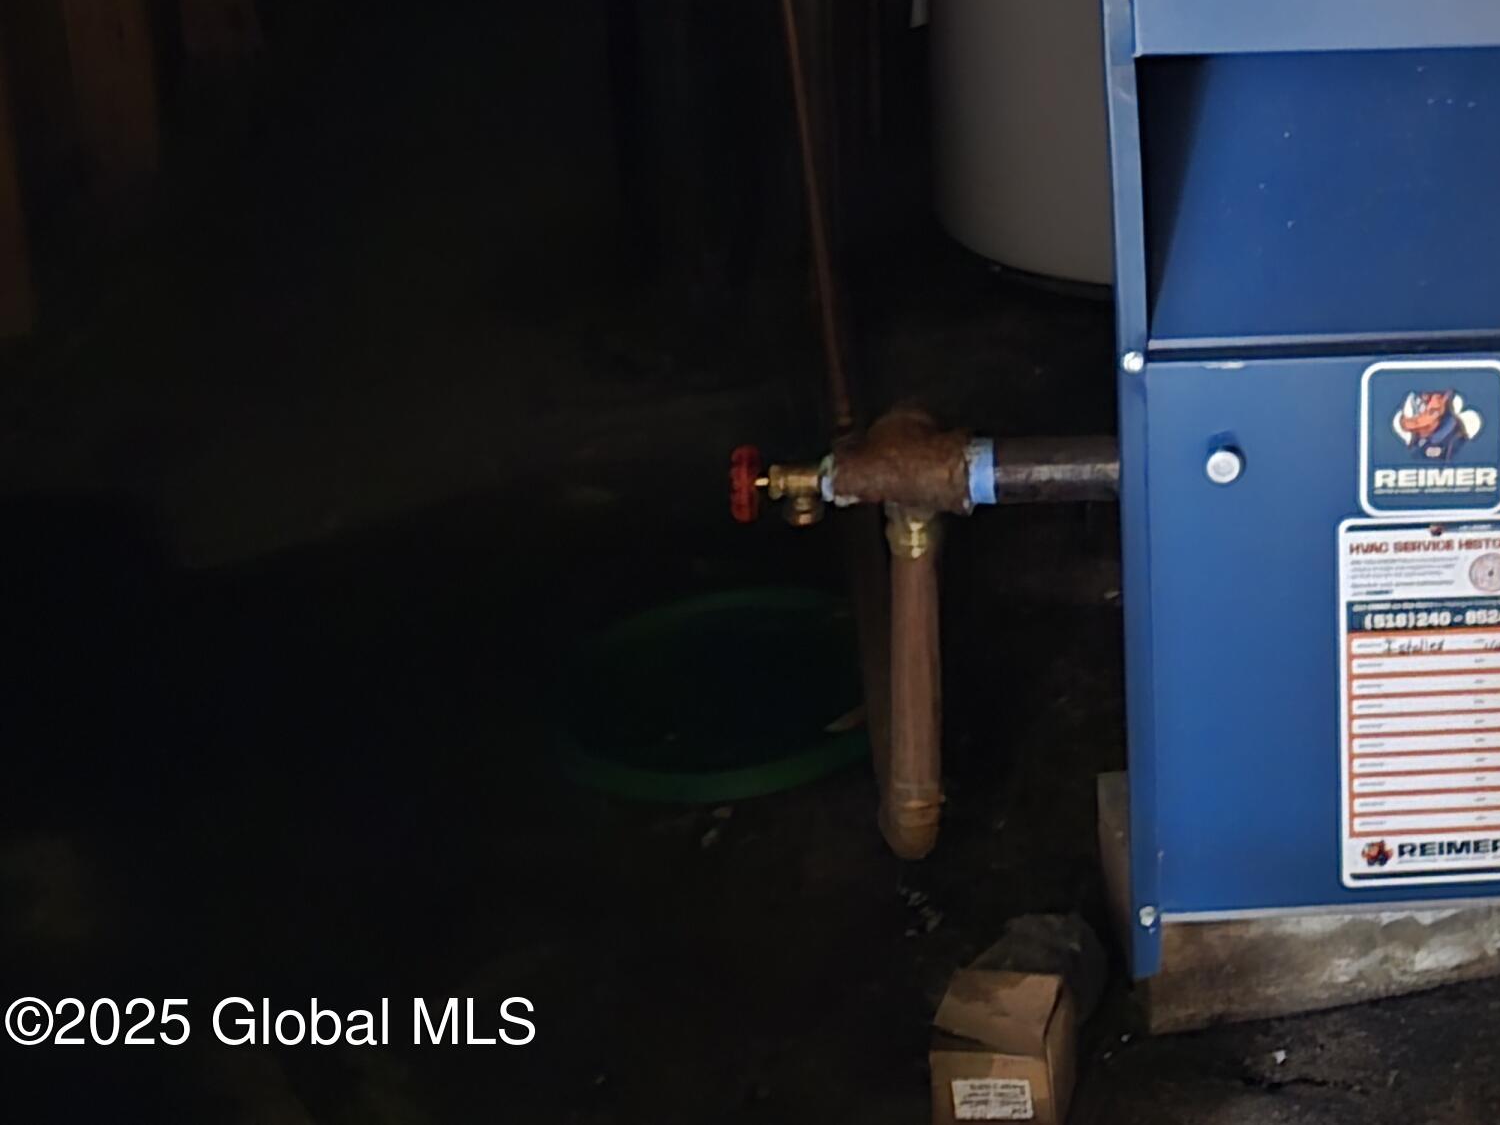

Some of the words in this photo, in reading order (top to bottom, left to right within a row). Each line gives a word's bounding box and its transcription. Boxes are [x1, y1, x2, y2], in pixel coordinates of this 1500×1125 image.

[1373, 467, 1498, 488] REIMER
[1349, 540, 1389, 555] HVAC
[1393, 538, 1455, 553] SERVICE
